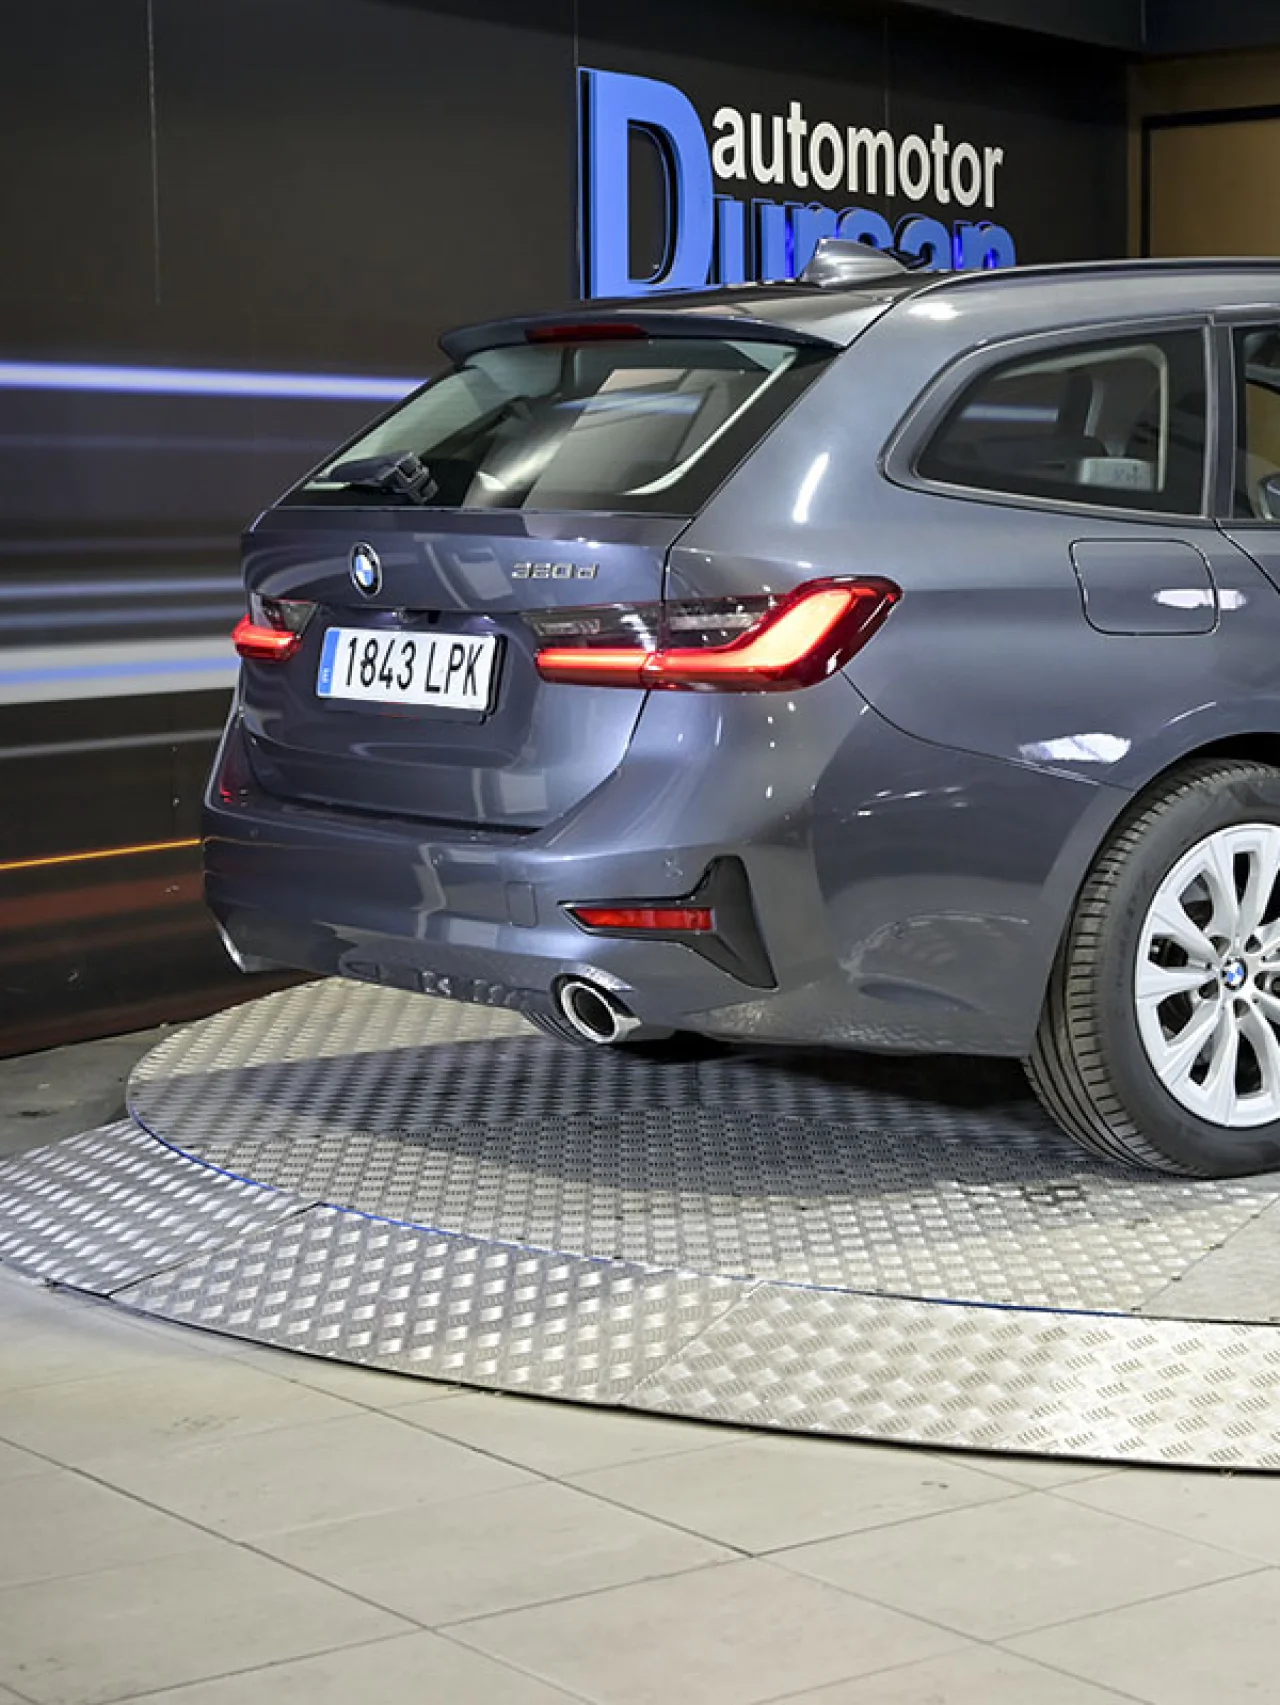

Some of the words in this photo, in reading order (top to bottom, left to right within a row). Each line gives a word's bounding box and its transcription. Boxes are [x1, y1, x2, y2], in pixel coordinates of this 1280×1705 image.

[711, 100, 1004, 208] automotor
[345, 637, 417, 690] 1843
[424, 641, 485, 696] LPK
